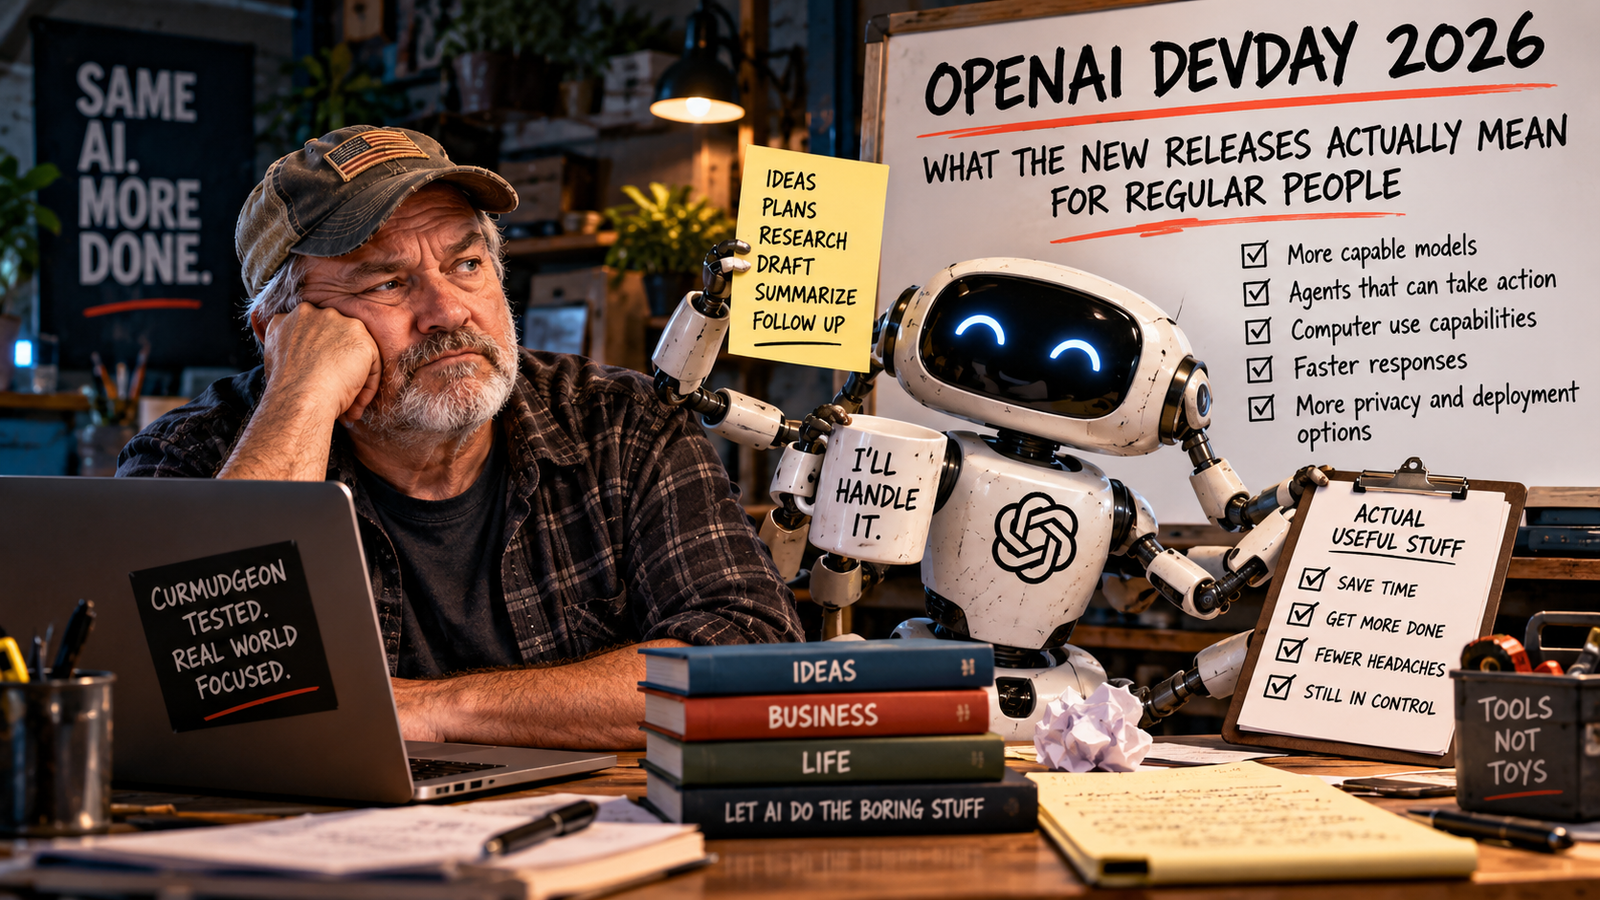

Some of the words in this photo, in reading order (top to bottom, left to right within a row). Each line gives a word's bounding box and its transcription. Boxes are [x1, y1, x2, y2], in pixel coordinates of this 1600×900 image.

[925, 44, 1122, 116] OPENAI
[1150, 20, 1358, 98] DEVDAY
[1386, 10, 1545, 79] 2026
[77, 63, 195, 121] SAME
[79, 121, 138, 173] AI.
[923, 149, 1000, 184] WHAT
[1012, 145, 1065, 177] THE
[1082, 138, 1149, 174] NEW
[1165, 129, 1311, 168] RELEASES
[1327, 119, 1462, 159] ACTUALLY
[1478, 113, 1567, 151] MEAN
[767, 169, 816, 191] IDEAS
[1051, 185, 1109, 218] FOR
[1125, 175, 1267, 213] REGULAR
[1282, 168, 1401, 206] PEOPLE
[80, 177, 199, 228] MORE
[763, 197, 816, 219] PLANS
[759, 226, 847, 250] RESEARCH
[1288, 243, 1333, 265] More
[1341, 237, 1406, 269] capable
[1415, 233, 1477, 258] models
[80, 233, 211, 284] DONE.
[757, 254, 815, 275] DRAFT
[755, 283, 857, 306] SUMMARIZE
[1289, 279, 1351, 310] Agents
[1358, 276, 1398, 298] that
[1407, 280, 1438, 295] can
[1446, 271, 1488, 294] take
[1497, 268, 1556, 290] action
[753, 310, 816, 331] FOLLOW
[824, 316, 845, 334] UP
[1292, 315, 1381, 346] Computer
[1390, 318, 1421, 334] use
[1430, 307, 1537, 340] capabilities
[1294, 354, 1359, 379] Faster
[1370, 353, 1467, 381] responses
[1296, 394, 1345, 416] More
[1355, 387, 1421, 421] privacy
[1430, 385, 1464, 408] and
[1473, 380, 1579, 414] deployment
[1298, 421, 1371, 452] options
[852, 447, 896, 476] I'LL
[836, 478, 920, 511] HANDLE
[852, 513, 881, 540] IT.
[1354, 503, 1425, 527] ACTUAL
[1332, 528, 1397, 550] USEFUL
[1406, 535, 1465, 558] STUFF
[151, 559, 286, 611] CURMUDGEON
[1337, 576, 1375, 592] SAVE
[1382, 581, 1418, 597] TIME
[182, 600, 269, 636] TESTED.
[1326, 611, 1357, 628] GET
[1360, 616, 1401, 633] MORE
[1406, 621, 1446, 638] DONE
[172, 642, 224, 672] REAL
[230, 625, 297, 657] WORLD
[1315, 647, 1362, 666] FEWER
[1367, 654, 1446, 677] HEADACHES
[195, 661, 291, 699] FOCUSED.
[793, 659, 856, 683] IDEAS
[1304, 684, 1342, 703] STILL
[1350, 691, 1366, 706] IN
[1371, 694, 1435, 715] CONTROL
[1478, 696, 1552, 722] TOOLS
[769, 703, 878, 728] BUSINESS
[1495, 728, 1541, 753] NOT
[803, 750, 850, 774] LIFE
[1487, 759, 1547, 786] TOYS
[725, 801, 758, 823] LET
[765, 801, 781, 822] AI
[791, 801, 813, 821] DO
[819, 800, 852, 820] THE
[860, 799, 924, 820] BORING
[932, 797, 984, 818] STUFF
